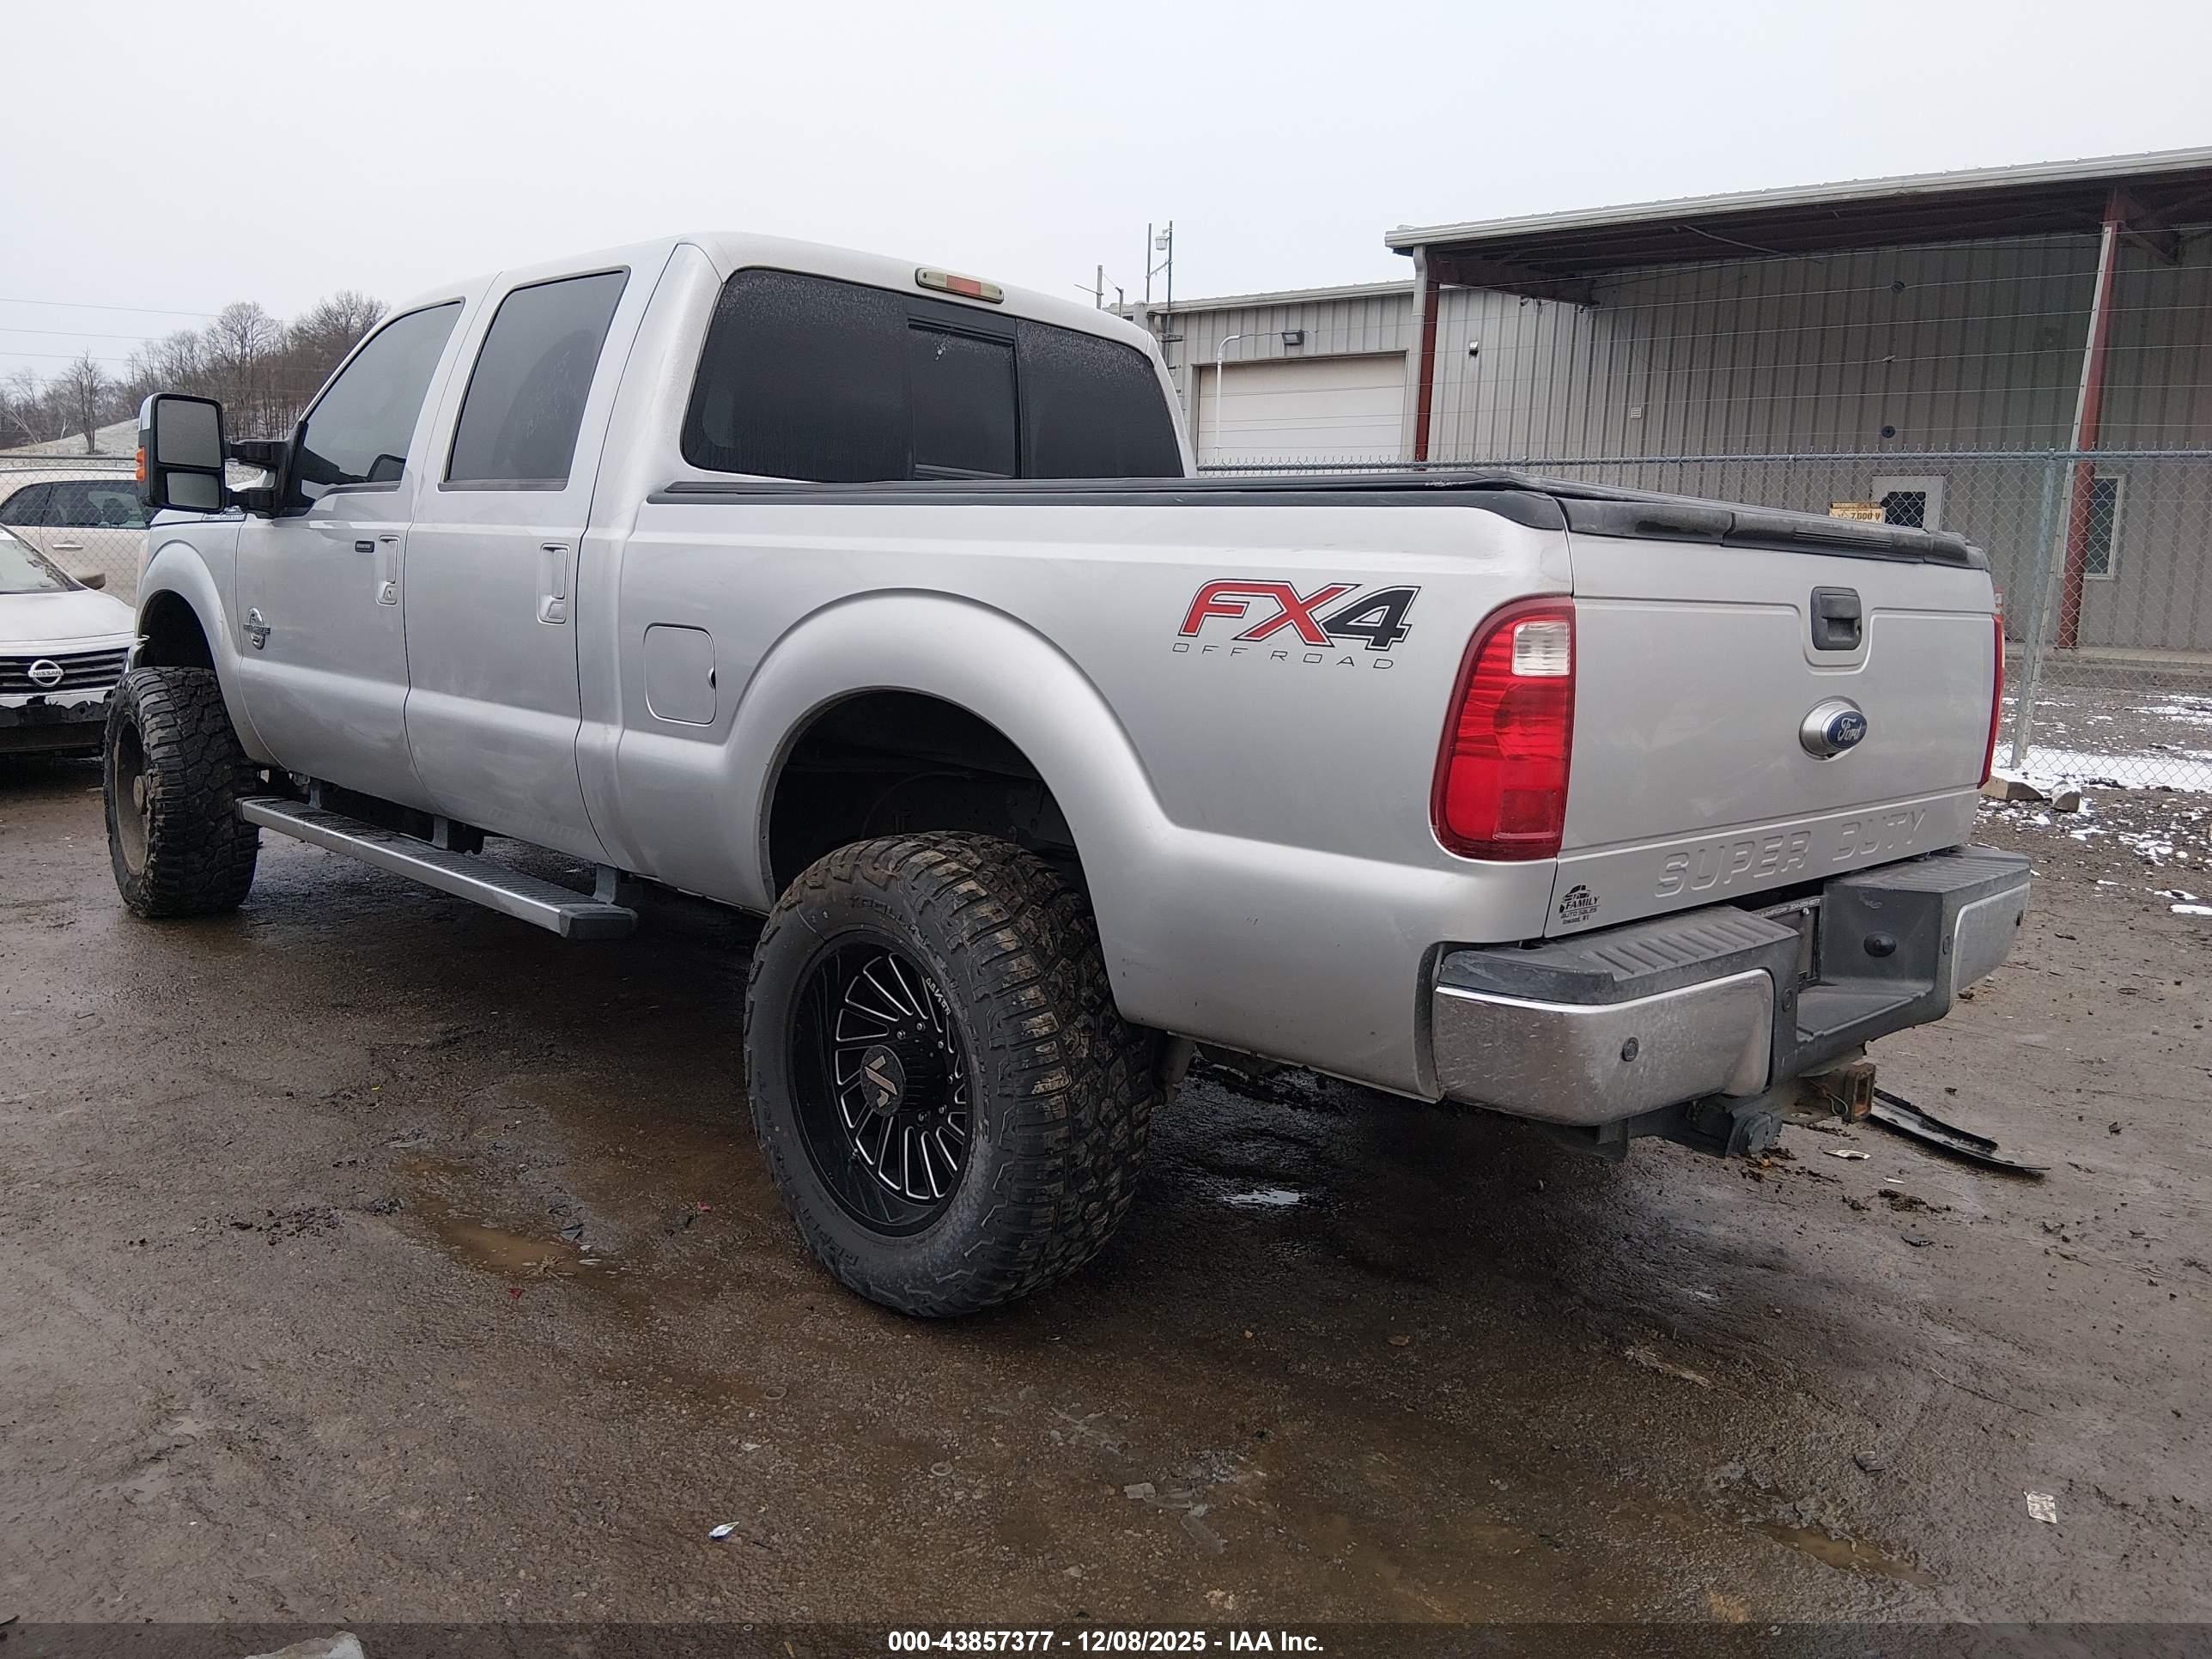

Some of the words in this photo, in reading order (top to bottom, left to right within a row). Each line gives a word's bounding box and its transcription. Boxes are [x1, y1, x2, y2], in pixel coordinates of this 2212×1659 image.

[1177, 578, 1422, 651] FX4
[1172, 642, 1249, 657] OFF
[1270, 650, 1395, 670] ROAD
[1837, 717, 1863, 742] Ford
[1655, 830, 1812, 898] SUPER
[1832, 809, 1926, 862] DUTY
[1560, 910, 1578, 919] AUTO
[1578, 907, 1598, 915] SALES
[1565, 896, 1601, 909] FAMILY
